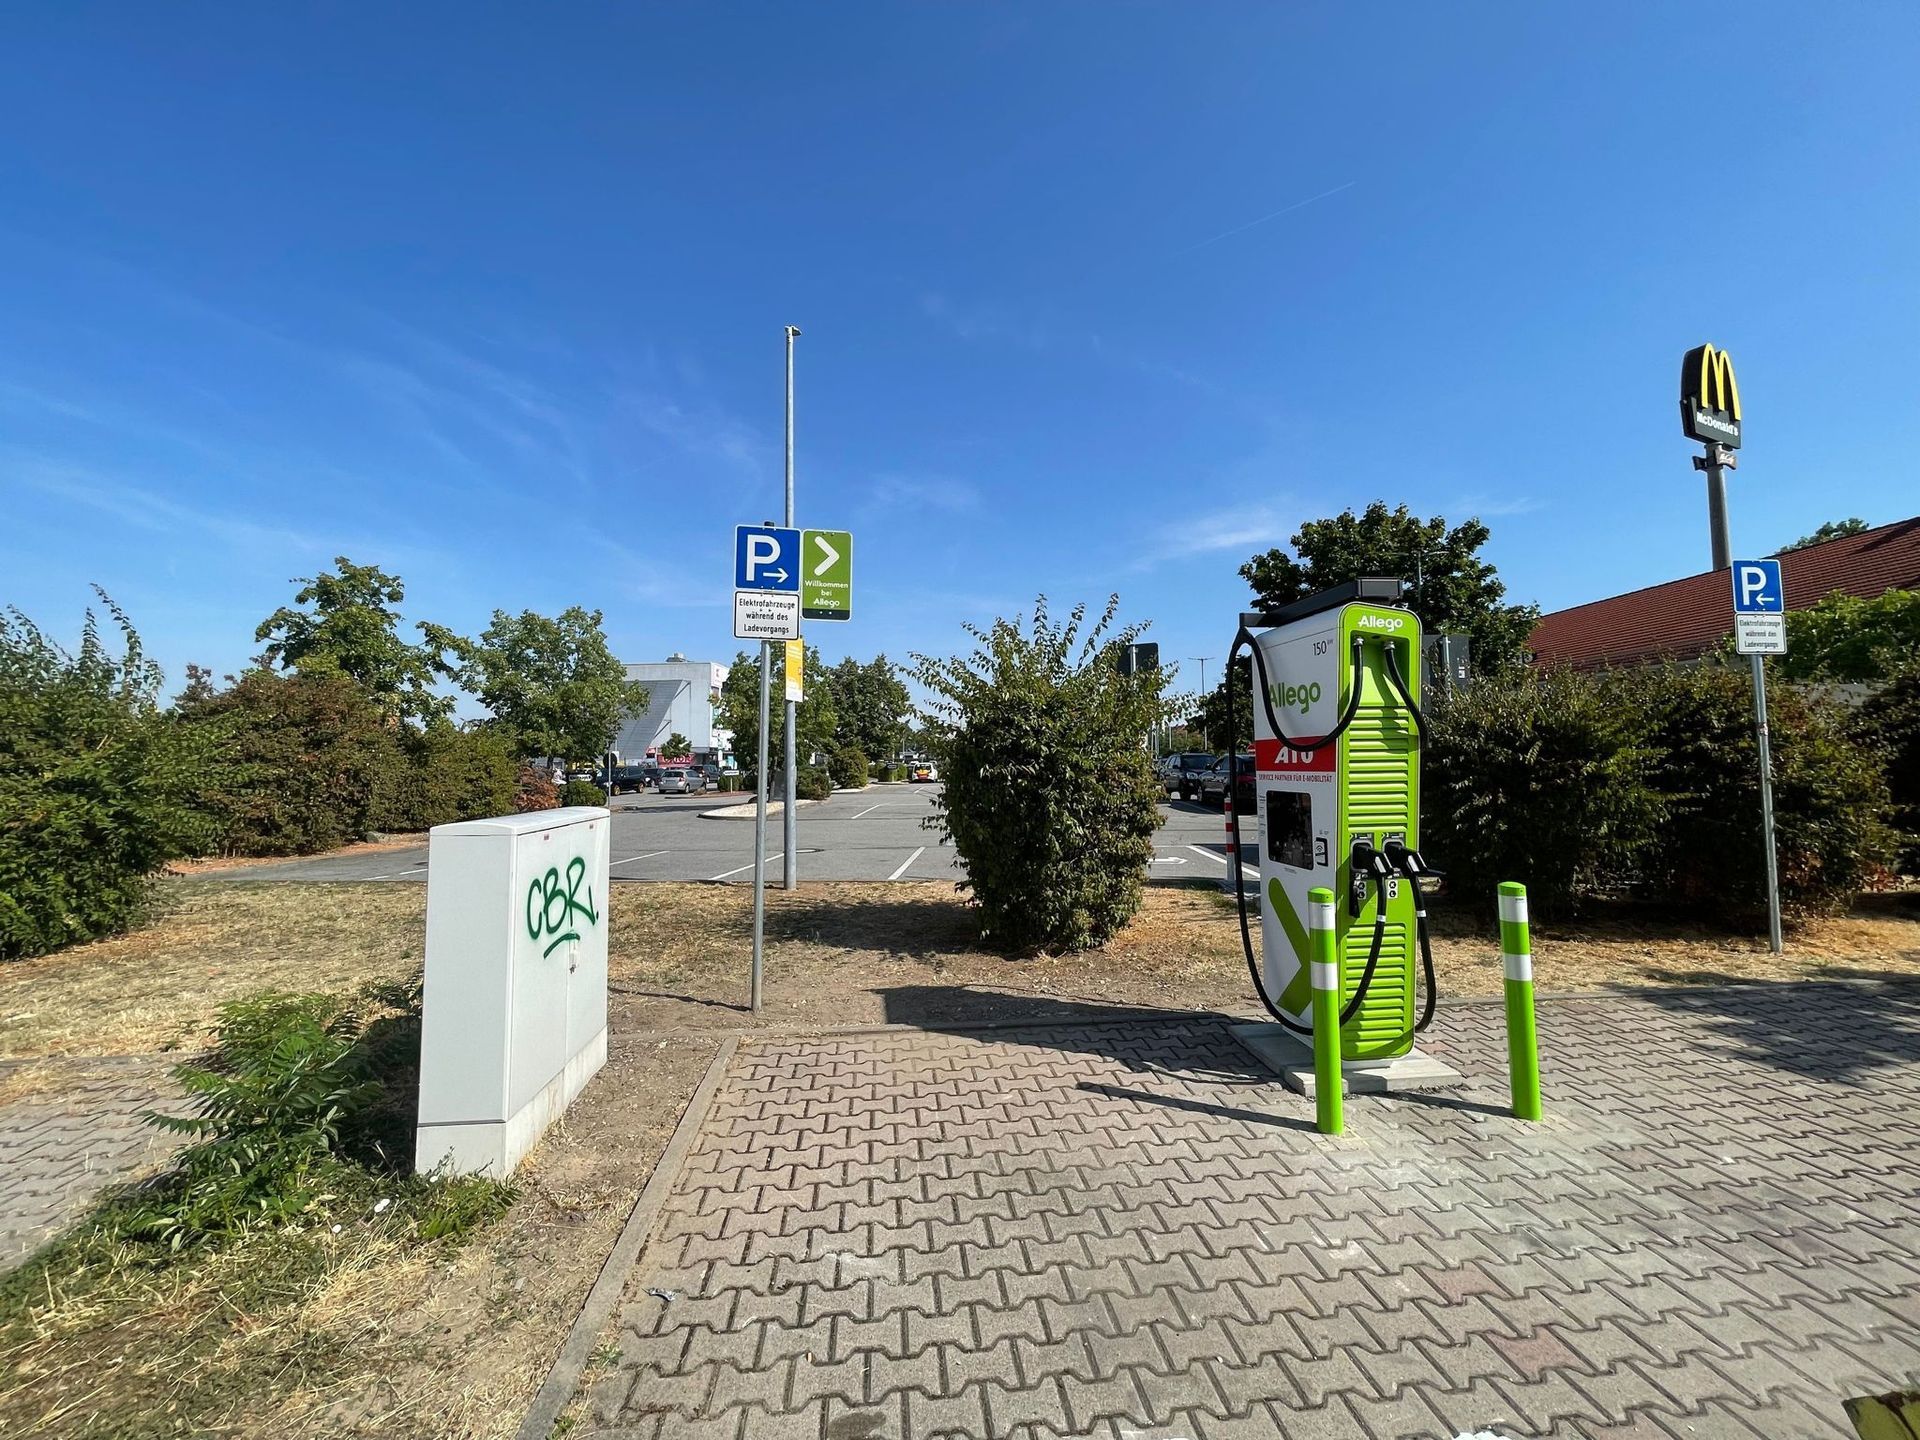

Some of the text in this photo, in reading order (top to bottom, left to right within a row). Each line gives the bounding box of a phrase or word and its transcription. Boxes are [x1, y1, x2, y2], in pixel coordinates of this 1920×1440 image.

[1696, 411, 1739, 437] McDonald's
[746, 534, 781, 582] P
[805, 580, 849, 589] Willkommen
[1741, 566, 1767, 606] P
[820, 589, 832, 597] bei
[739, 598, 796, 610] Elektrofahrzeuge
[813, 598, 840, 609] Allego
[746, 611, 789, 621] während des
[1358, 613, 1404, 633] Allego
[743, 623, 790, 636] Ladevorgangs
[1313, 640, 1327, 656] 150
[1269, 682, 1321, 715] Allego
